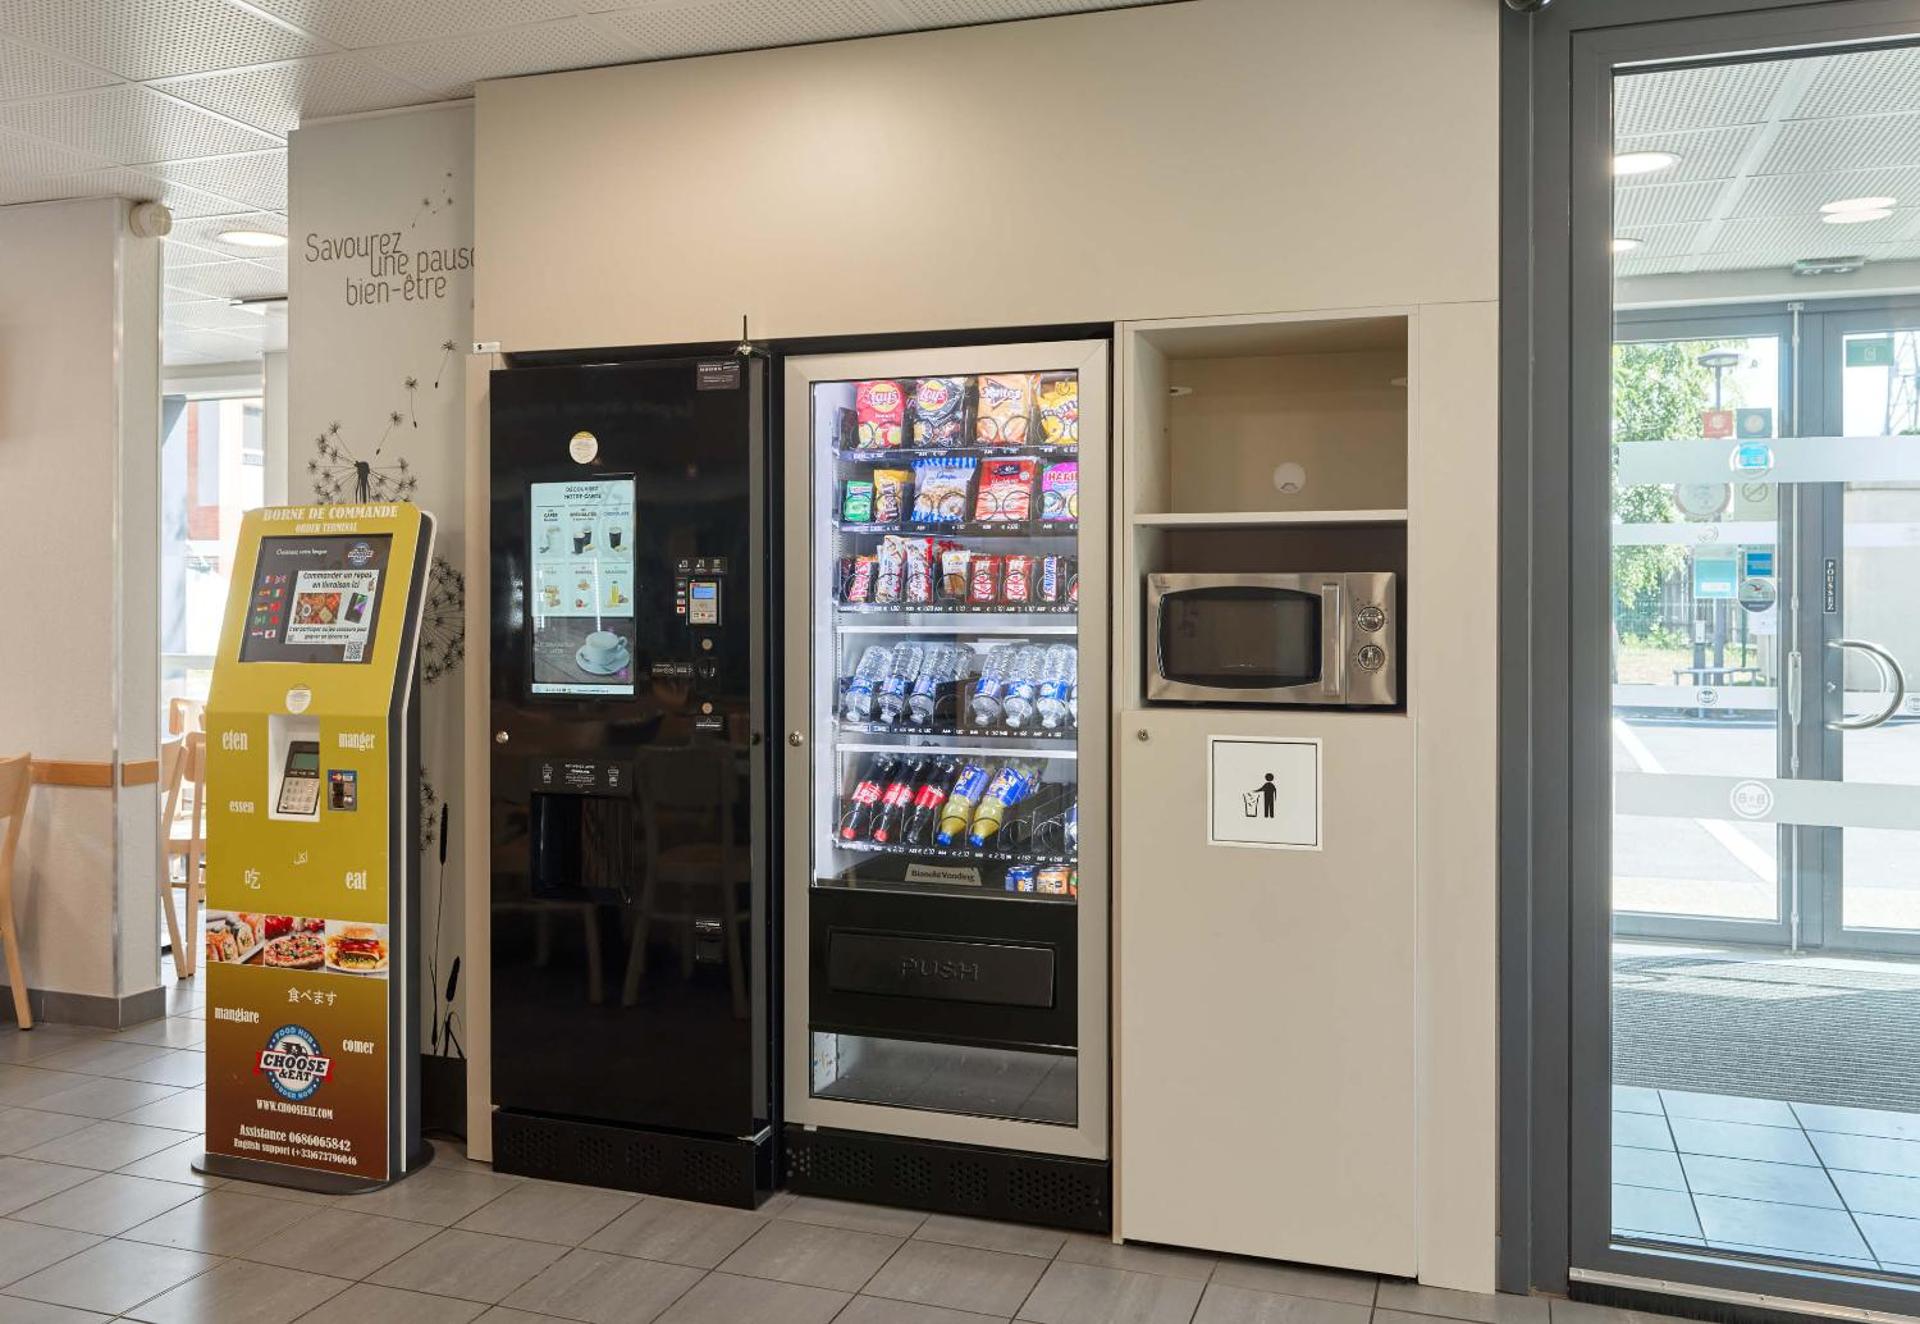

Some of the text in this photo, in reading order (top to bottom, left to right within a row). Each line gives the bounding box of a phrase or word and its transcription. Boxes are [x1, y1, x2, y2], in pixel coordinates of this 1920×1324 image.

[305, 232, 402, 262] Savourez
[370, 253, 409, 278] une
[346, 274, 447, 306] bien-être
[263, 504, 399, 521] BORNE DE COMMANDE
[303, 571, 341, 580] Commander
[322, 580, 350, 589] livraison
[222, 729, 248, 750] eten
[338, 732, 375, 751] manger
[229, 800, 254, 814] essen
[345, 870, 367, 890] eat
[901, 959, 979, 981] PUSH
[287, 987, 337, 1007] 食べます
[214, 1007, 260, 1024] mangiare
[342, 1038, 374, 1054] comer
[263, 1052, 326, 1073] CHOOSE
[279, 1069, 312, 1082] &EAT
[239, 1124, 287, 1142] Assistance
[233, 1138, 260, 1152] English
[262, 1143, 290, 1157] support
